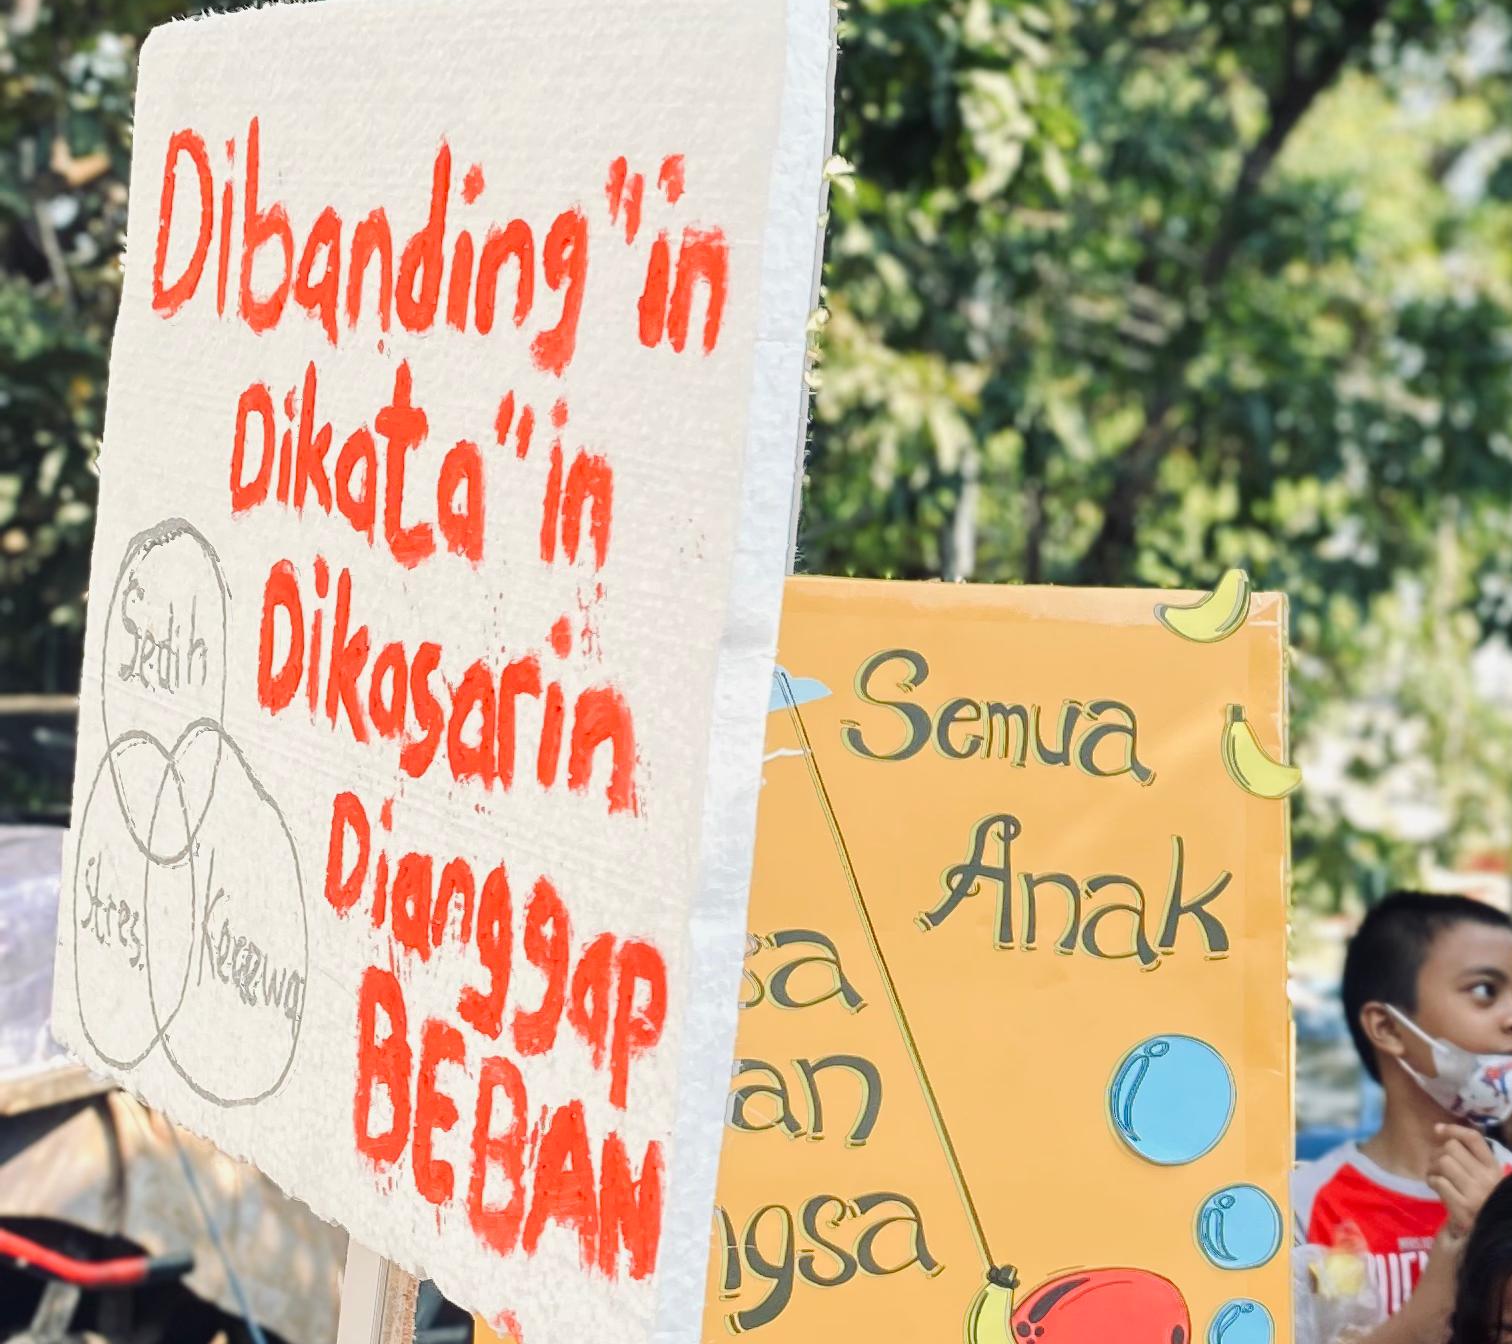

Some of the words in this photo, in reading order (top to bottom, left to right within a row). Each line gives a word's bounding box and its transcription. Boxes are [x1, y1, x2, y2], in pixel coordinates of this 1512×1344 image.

[118, 570, 208, 694] Sedih
[256, 556, 637, 816] Dikasarin
[841, 648, 1154, 786] Semua
[325, 791, 668, 1109] Dianggap
[915, 813, 1232, 971] Anak
[354, 964, 662, 1281] BEBAN
